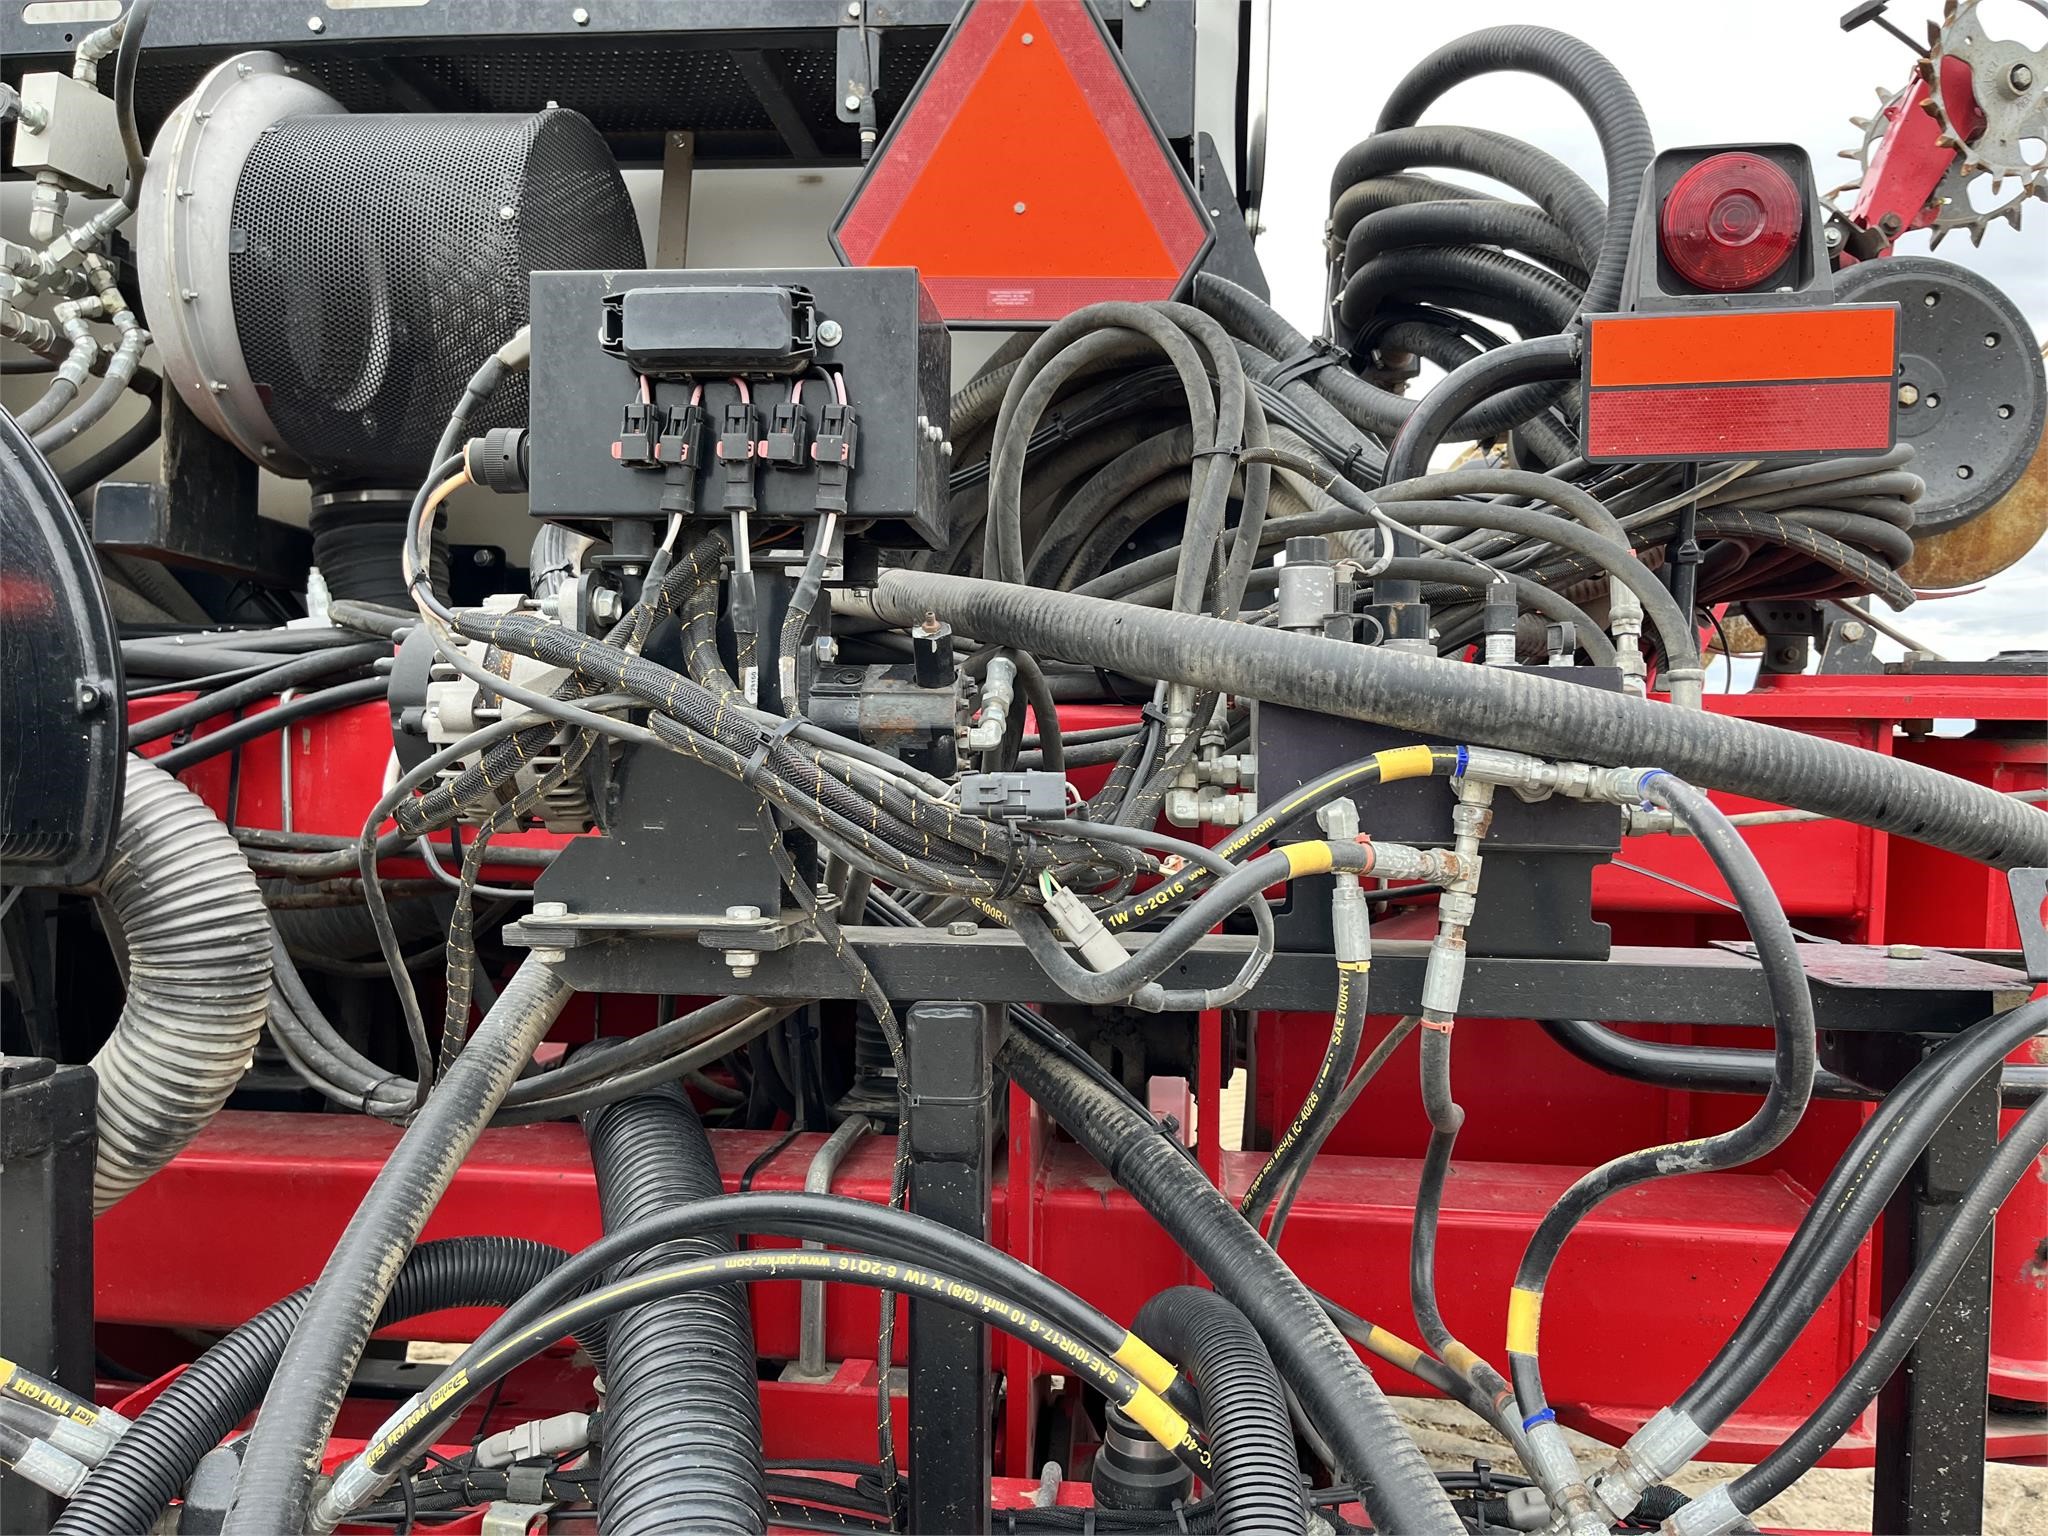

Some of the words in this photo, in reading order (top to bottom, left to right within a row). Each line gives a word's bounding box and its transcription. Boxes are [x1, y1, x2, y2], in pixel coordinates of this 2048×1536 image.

[1108, 910, 1129, 927] 1W
[1134, 881, 1185, 917] 6-2Q16
[1292, 1091, 1320, 1137] IC-40/26
[725, 1254, 831, 1269] www.parker.com
[838, 1256, 898, 1279] 6-2Q16
[903, 1269, 929, 1287] 1W
[931, 1276, 946, 1291] X
[947, 1281, 979, 1305] (3/8)
[982, 1296, 1010, 1315] mm
[1010, 1307, 1026, 1326] 10
[12, 1378, 73, 1417] TOUGH
